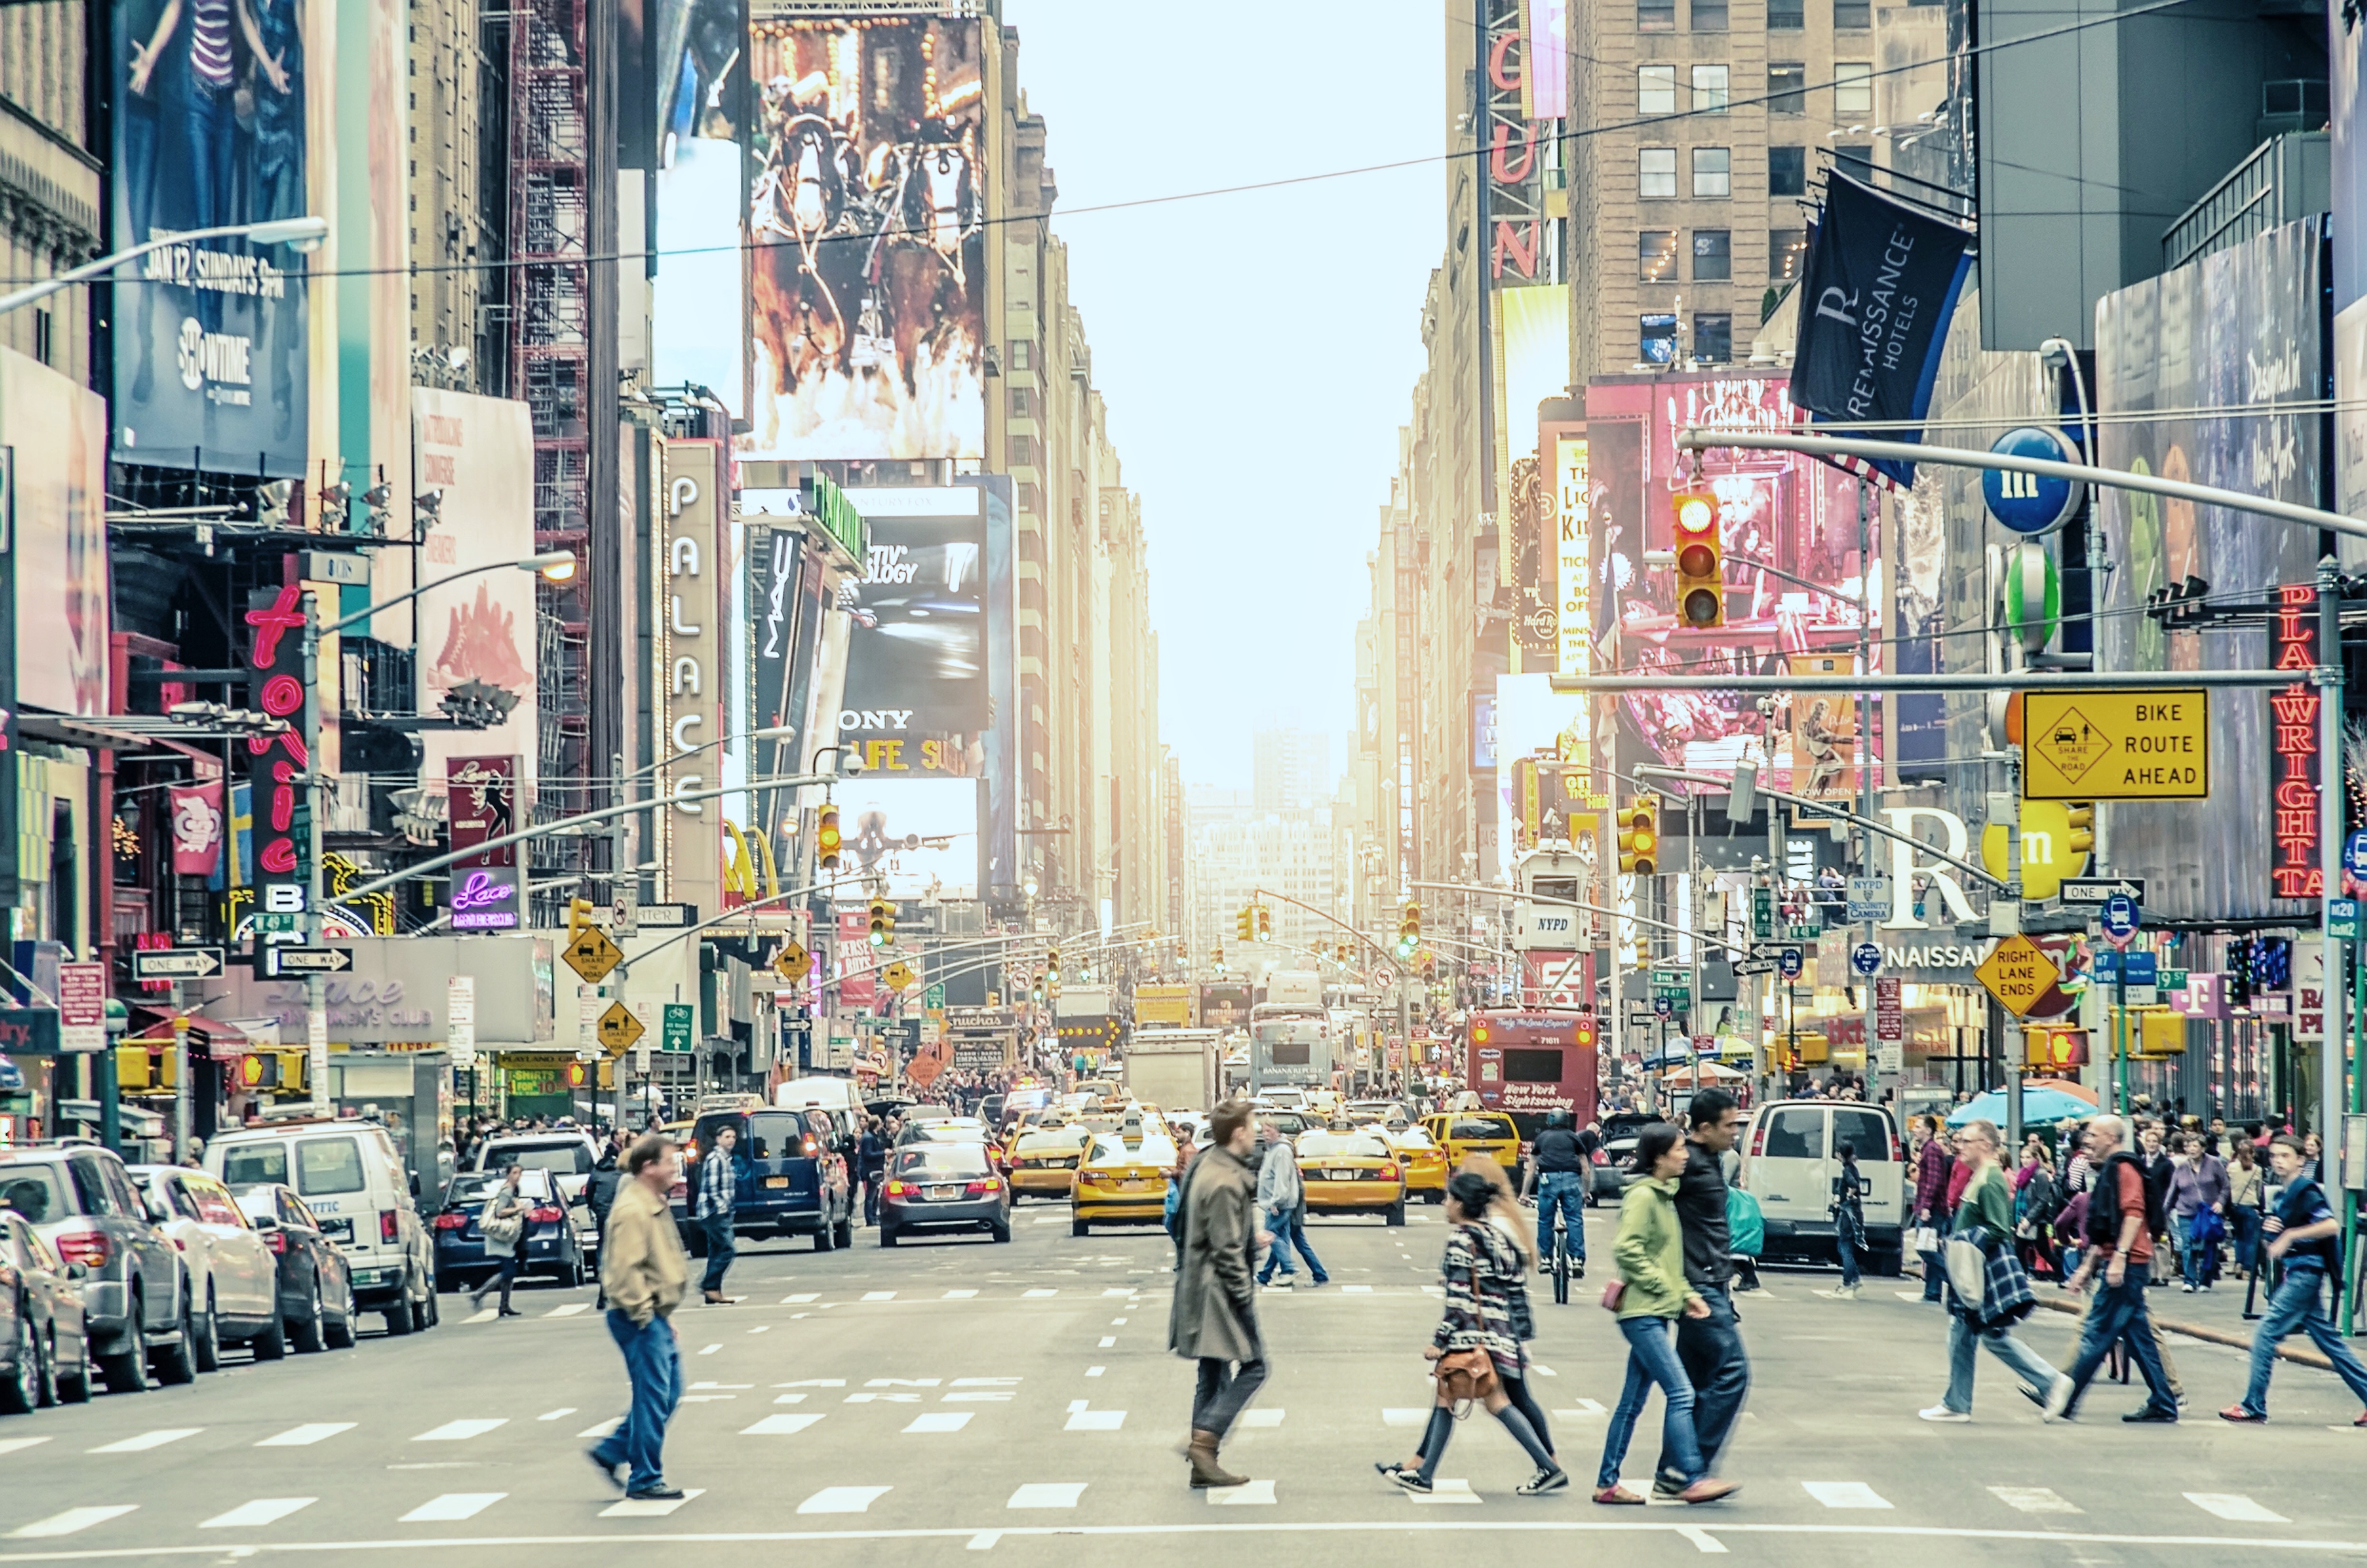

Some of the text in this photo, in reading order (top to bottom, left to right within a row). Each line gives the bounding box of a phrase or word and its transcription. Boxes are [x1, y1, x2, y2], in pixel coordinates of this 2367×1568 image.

[145, 246, 284, 299] JAN 12 SUNDAYS 9PM
[1847, 228, 1914, 418] RENAISSANCE
[1882, 294, 1918, 371] HOTELS
[178, 317, 251, 390] SHOWTIME
[424, 414, 463, 447] INTRODUCING
[425, 453, 454, 486] CONVERSE
[425, 533, 456, 565] SNEAKERS
[1524, 615, 1558, 628] Hard Ro
[669, 476, 703, 814] PALACE
[2136, 705, 2182, 722] BIKE
[838, 710, 913, 731] ONY
[2270, 586, 2320, 865] PLAWRIGHT
[2058, 745, 2088, 755] SHARE
[2125, 735, 2193, 754] ROUTE
[2061, 763, 2085, 771] ROAD
[2123, 767, 2197, 784] AHEAD
[1797, 787, 1851, 797] NOW OPEN
[1880, 807, 1983, 930] R
[452, 871, 512, 911] Lace
[1855, 881, 1883, 889] NYPD
[2072, 887, 2133, 898] ONE WAY
[1848, 901, 1888, 910] SECURITY
[2331, 903, 2354, 917] M20
[1850, 910, 1887, 919] CAMERA
[255, 916, 264, 931] W
[1538, 918, 1568, 931] NYPD
[148, 957, 211, 970] ONE WAY
[288, 954, 342, 965] ONE WAY
[581, 956, 606, 964] SHARE
[1884, 946, 1987, 968] NAISSA
[1997, 951, 2035, 963] RIGHT
[845, 955, 872, 975] BOYS
[1760, 961, 1775, 969] WAY
[1656, 972, 1691, 983] Broaay
[1999, 967, 2035, 980] LANE
[2174, 971, 2185, 980] ST
[1670, 989, 1680, 997] 47
[2000, 983, 2034, 997] ENDS
[2181, 979, 2209, 1013] T
[953, 1013, 1002, 1026] nuchas
[1527, 1018, 1544, 1028] Local
[1262, 1066, 1326, 1075] BANANA REPUBLIC
[1503, 1083, 1557, 1095] New York
[1502, 1095, 1574, 1109] Sightseeing
